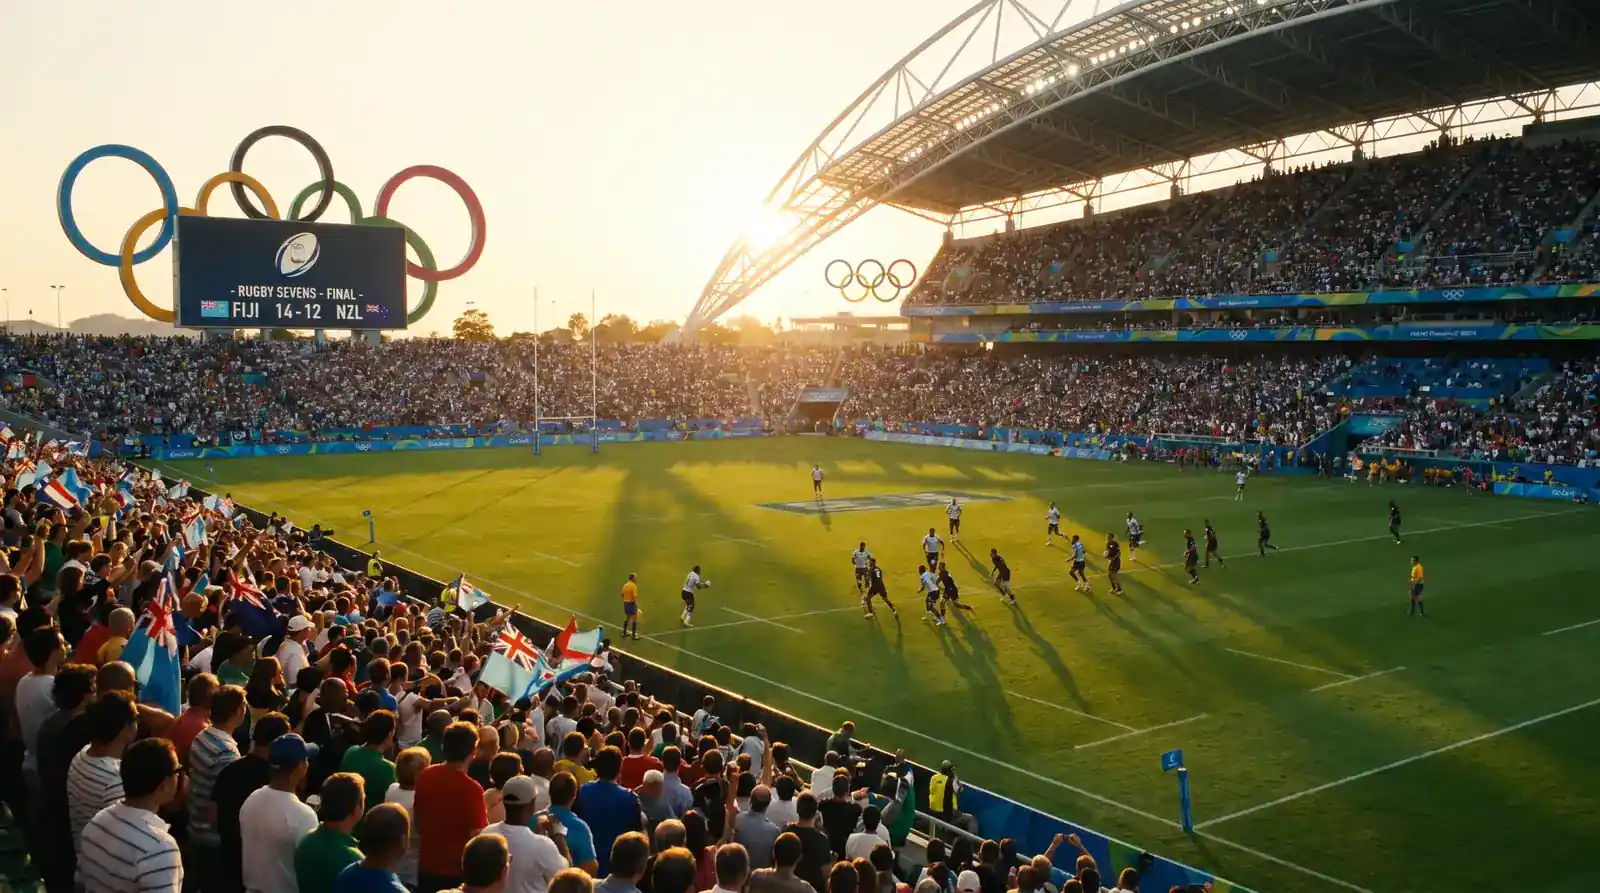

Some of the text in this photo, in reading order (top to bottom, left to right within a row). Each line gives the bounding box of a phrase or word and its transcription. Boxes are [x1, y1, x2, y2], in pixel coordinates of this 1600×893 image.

[238, 285, 274, 298] RUGBY
[276, 286, 317, 299] SEVENS
[326, 287, 357, 300] FINAL
[232, 302, 259, 318] FIJI
[336, 304, 364, 320] NZL
